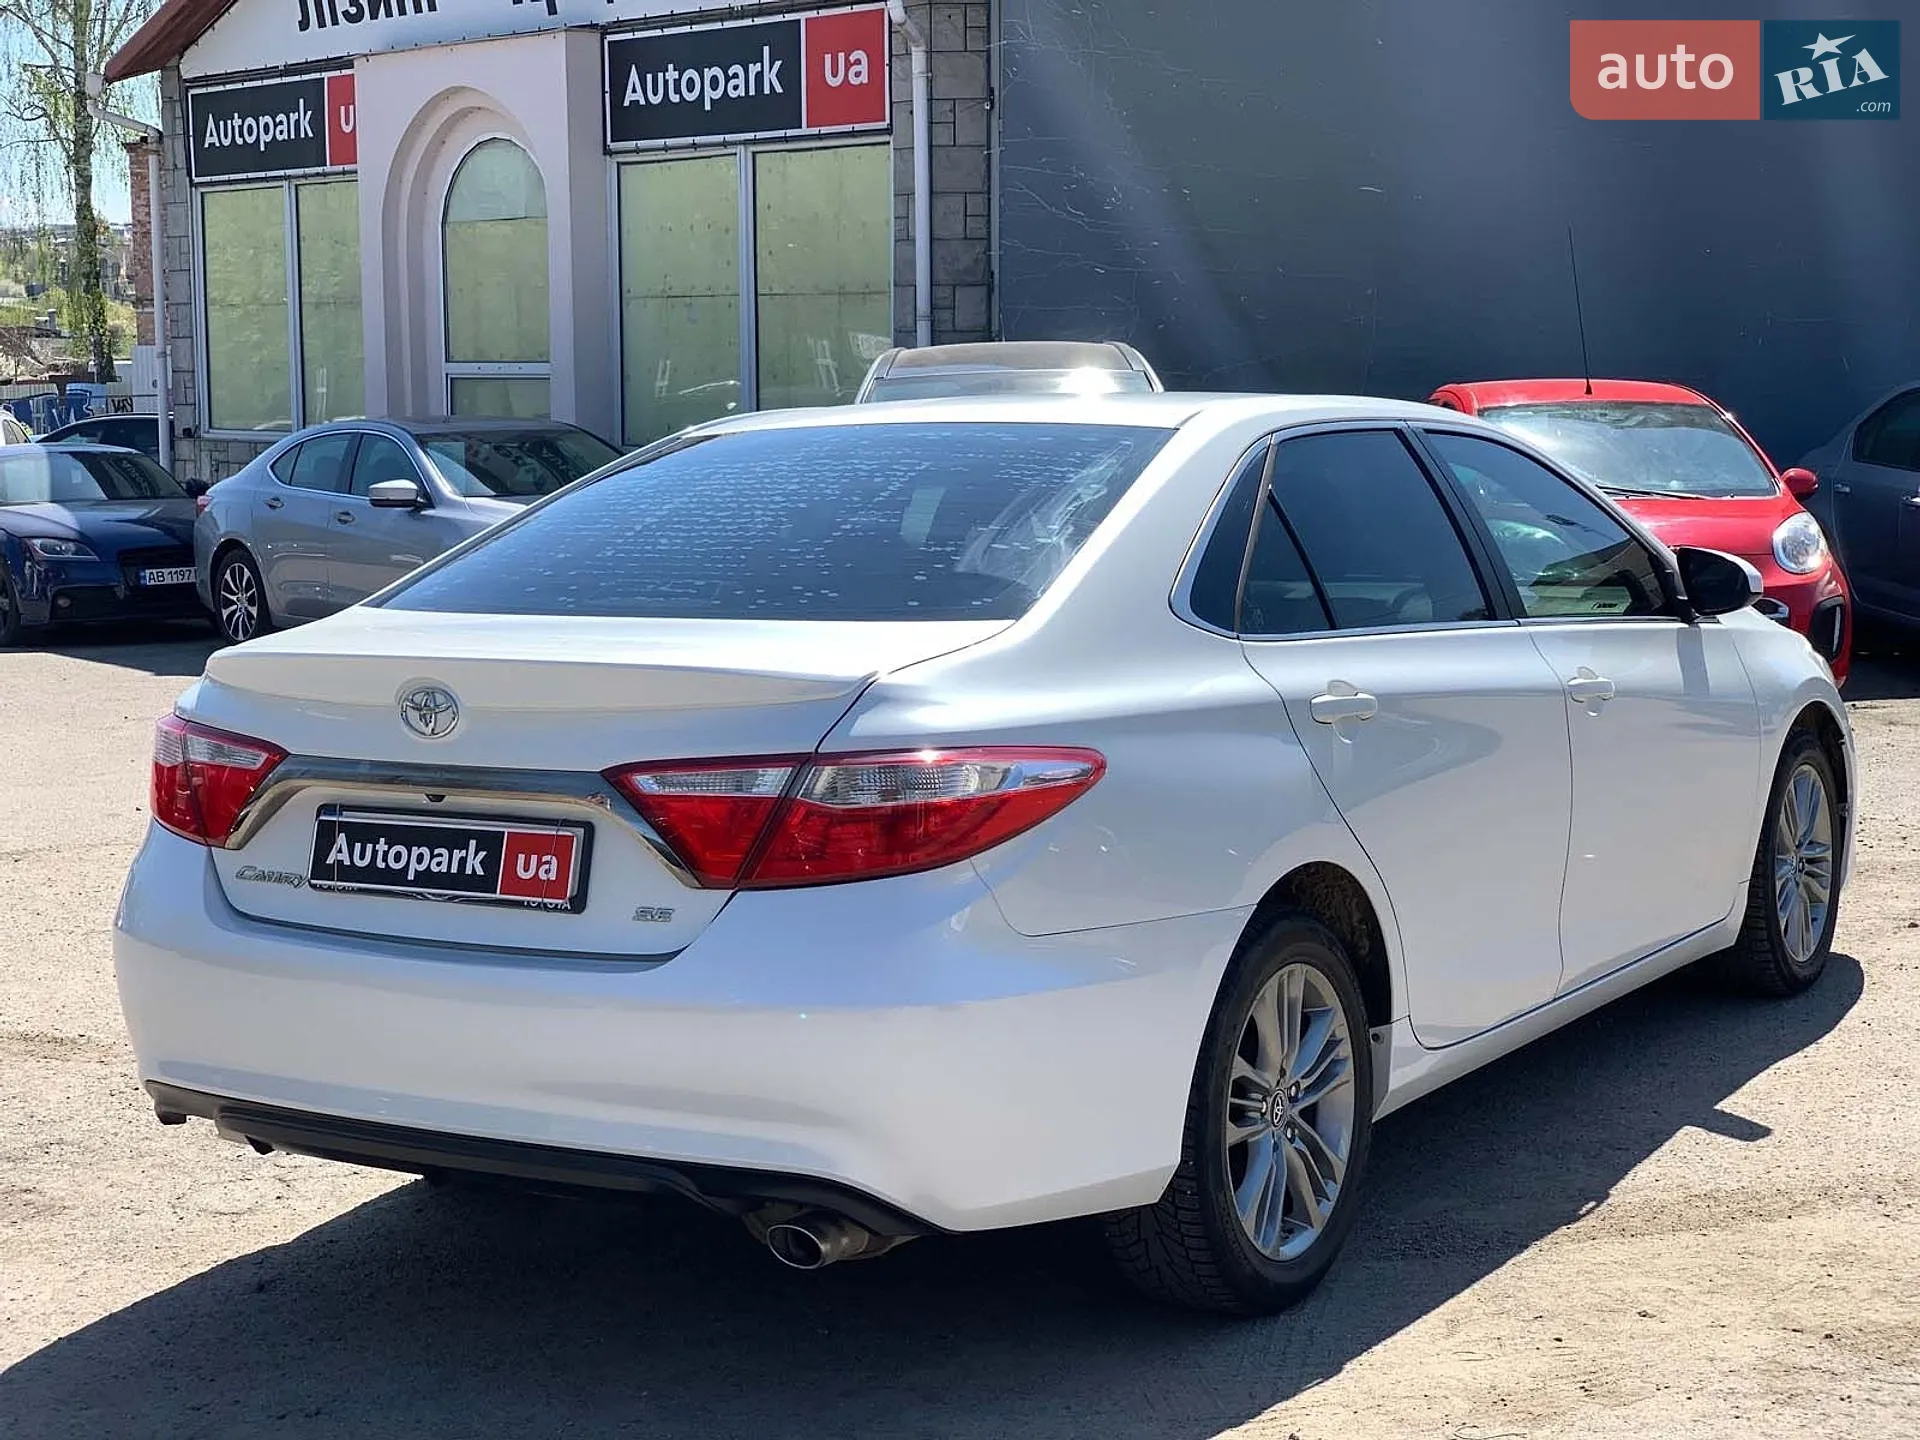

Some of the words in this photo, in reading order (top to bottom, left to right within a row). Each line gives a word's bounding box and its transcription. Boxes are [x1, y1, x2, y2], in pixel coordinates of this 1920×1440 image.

[622, 45, 785, 112] Autopark
[823, 49, 869, 88] ua
[203, 98, 314, 152] Autopark
[148, 570, 166, 583] AB
[167, 569, 192, 582] 1197
[325, 832, 488, 881] Autopark
[515, 851, 559, 881] ua
